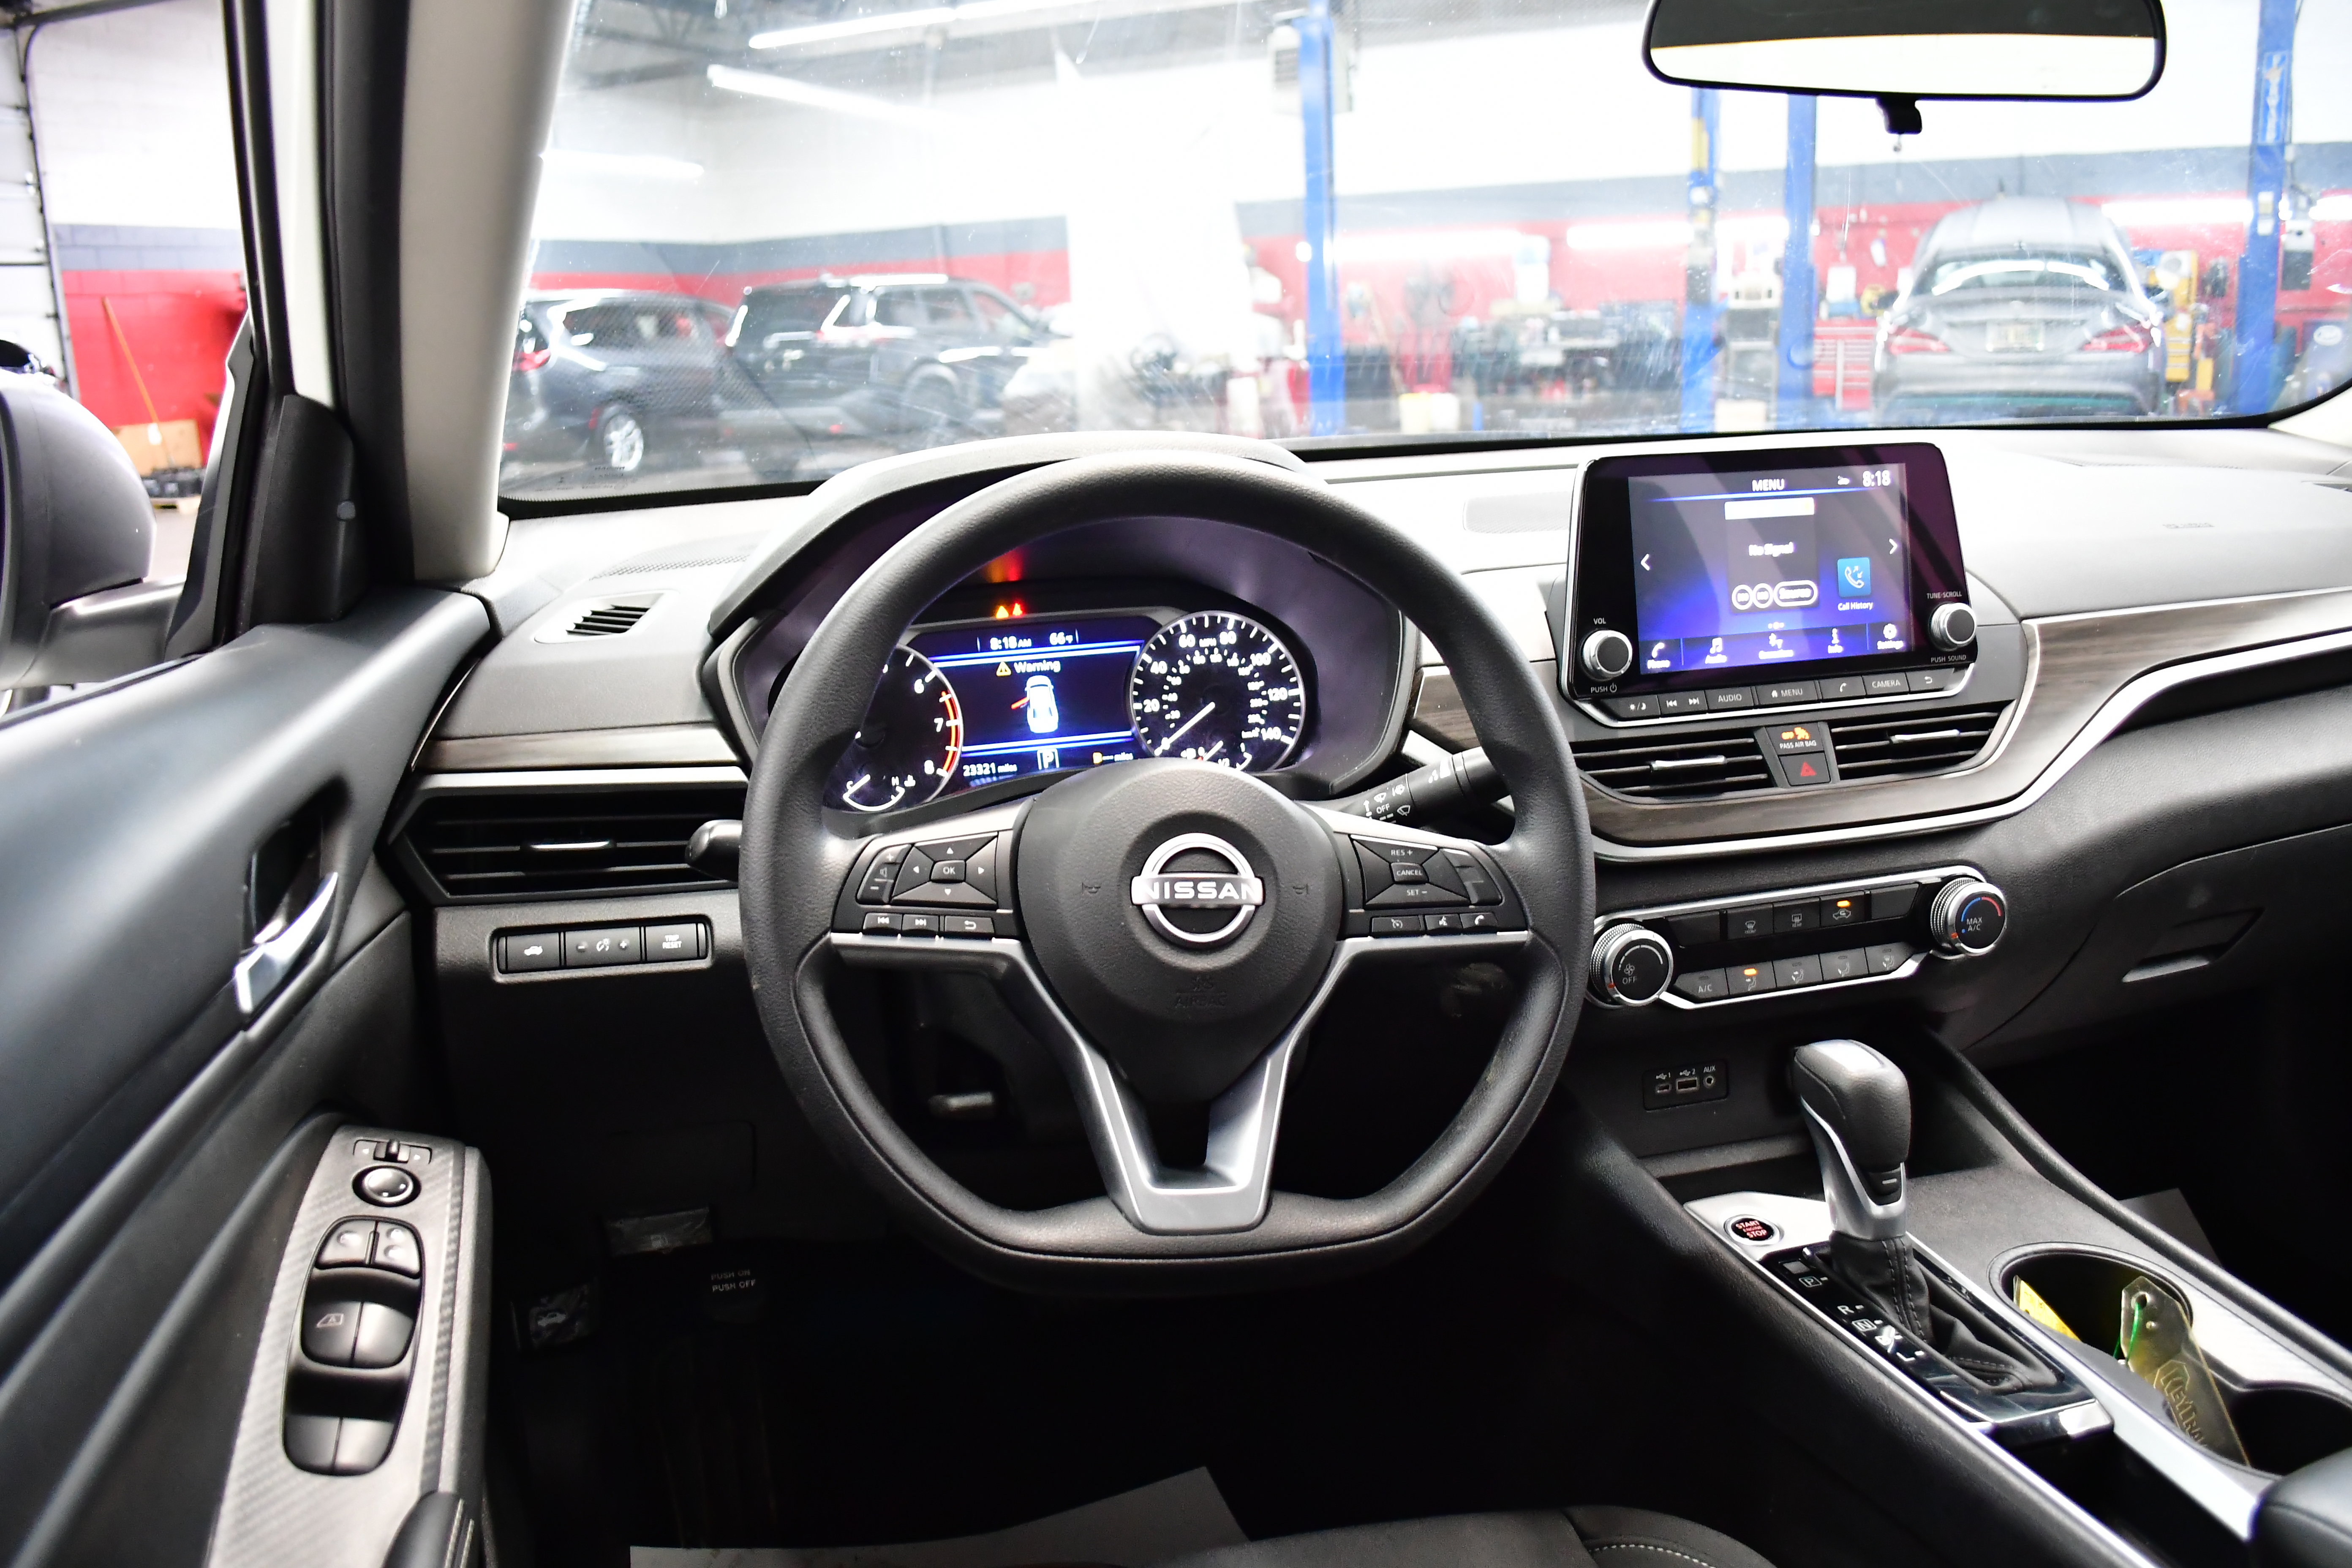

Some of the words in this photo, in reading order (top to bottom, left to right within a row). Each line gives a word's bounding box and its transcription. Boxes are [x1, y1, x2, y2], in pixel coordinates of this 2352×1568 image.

[1863, 470, 1891, 487] 8:18
[1752, 479, 1785, 491] MENU
[1838, 602, 1850, 611] Call
[1850, 602, 1873, 610] History
[990, 636, 1018, 650] 8:18
[1179, 634, 1195, 648] 60
[1220, 631, 1236, 645] 80
[1250, 653, 1271, 666] 100
[1014, 660, 1061, 673] Warning
[1150, 661, 1167, 674] 40
[914, 679, 924, 694] 6
[1872, 679, 1900, 689] CAMERA
[1268, 687, 1288, 701] 120
[1591, 686, 1608, 694] PUSH
[1781, 688, 1803, 697] MENU
[1718, 693, 1742, 703] AUDIO
[1143, 698, 1160, 713] 20
[934, 717, 944, 732] 7
[1261, 727, 1282, 740] 140
[1042, 751, 1054, 769] P
[924, 760, 934, 775] 8
[963, 762, 996, 777] 23321
[997, 763, 1018, 773] miles
[891, 776, 899, 786] H
[1376, 803, 1390, 814] OFF
[943, 866, 956, 875] OK
[1142, 881, 1259, 899] NISSAN
[1966, 917, 1982, 925] MAX
[1967, 923, 1981, 932] A/C
[1622, 976, 1637, 985] OFF
[1698, 984, 1712, 994] A/C
[1703, 1064, 1716, 1073] AUX
[1735, 1220, 1760, 1229] START
[1746, 1229, 1767, 1238] STOP
[711, 1271, 735, 1280] PUSH
[712, 1283, 736, 1292] PUSH
[739, 1279, 756, 1288] OFF
[1805, 1277, 1816, 1286] P
[1837, 1305, 1854, 1315] R
[1859, 1320, 1873, 1330] N
[1896, 1352, 1915, 1361] L
